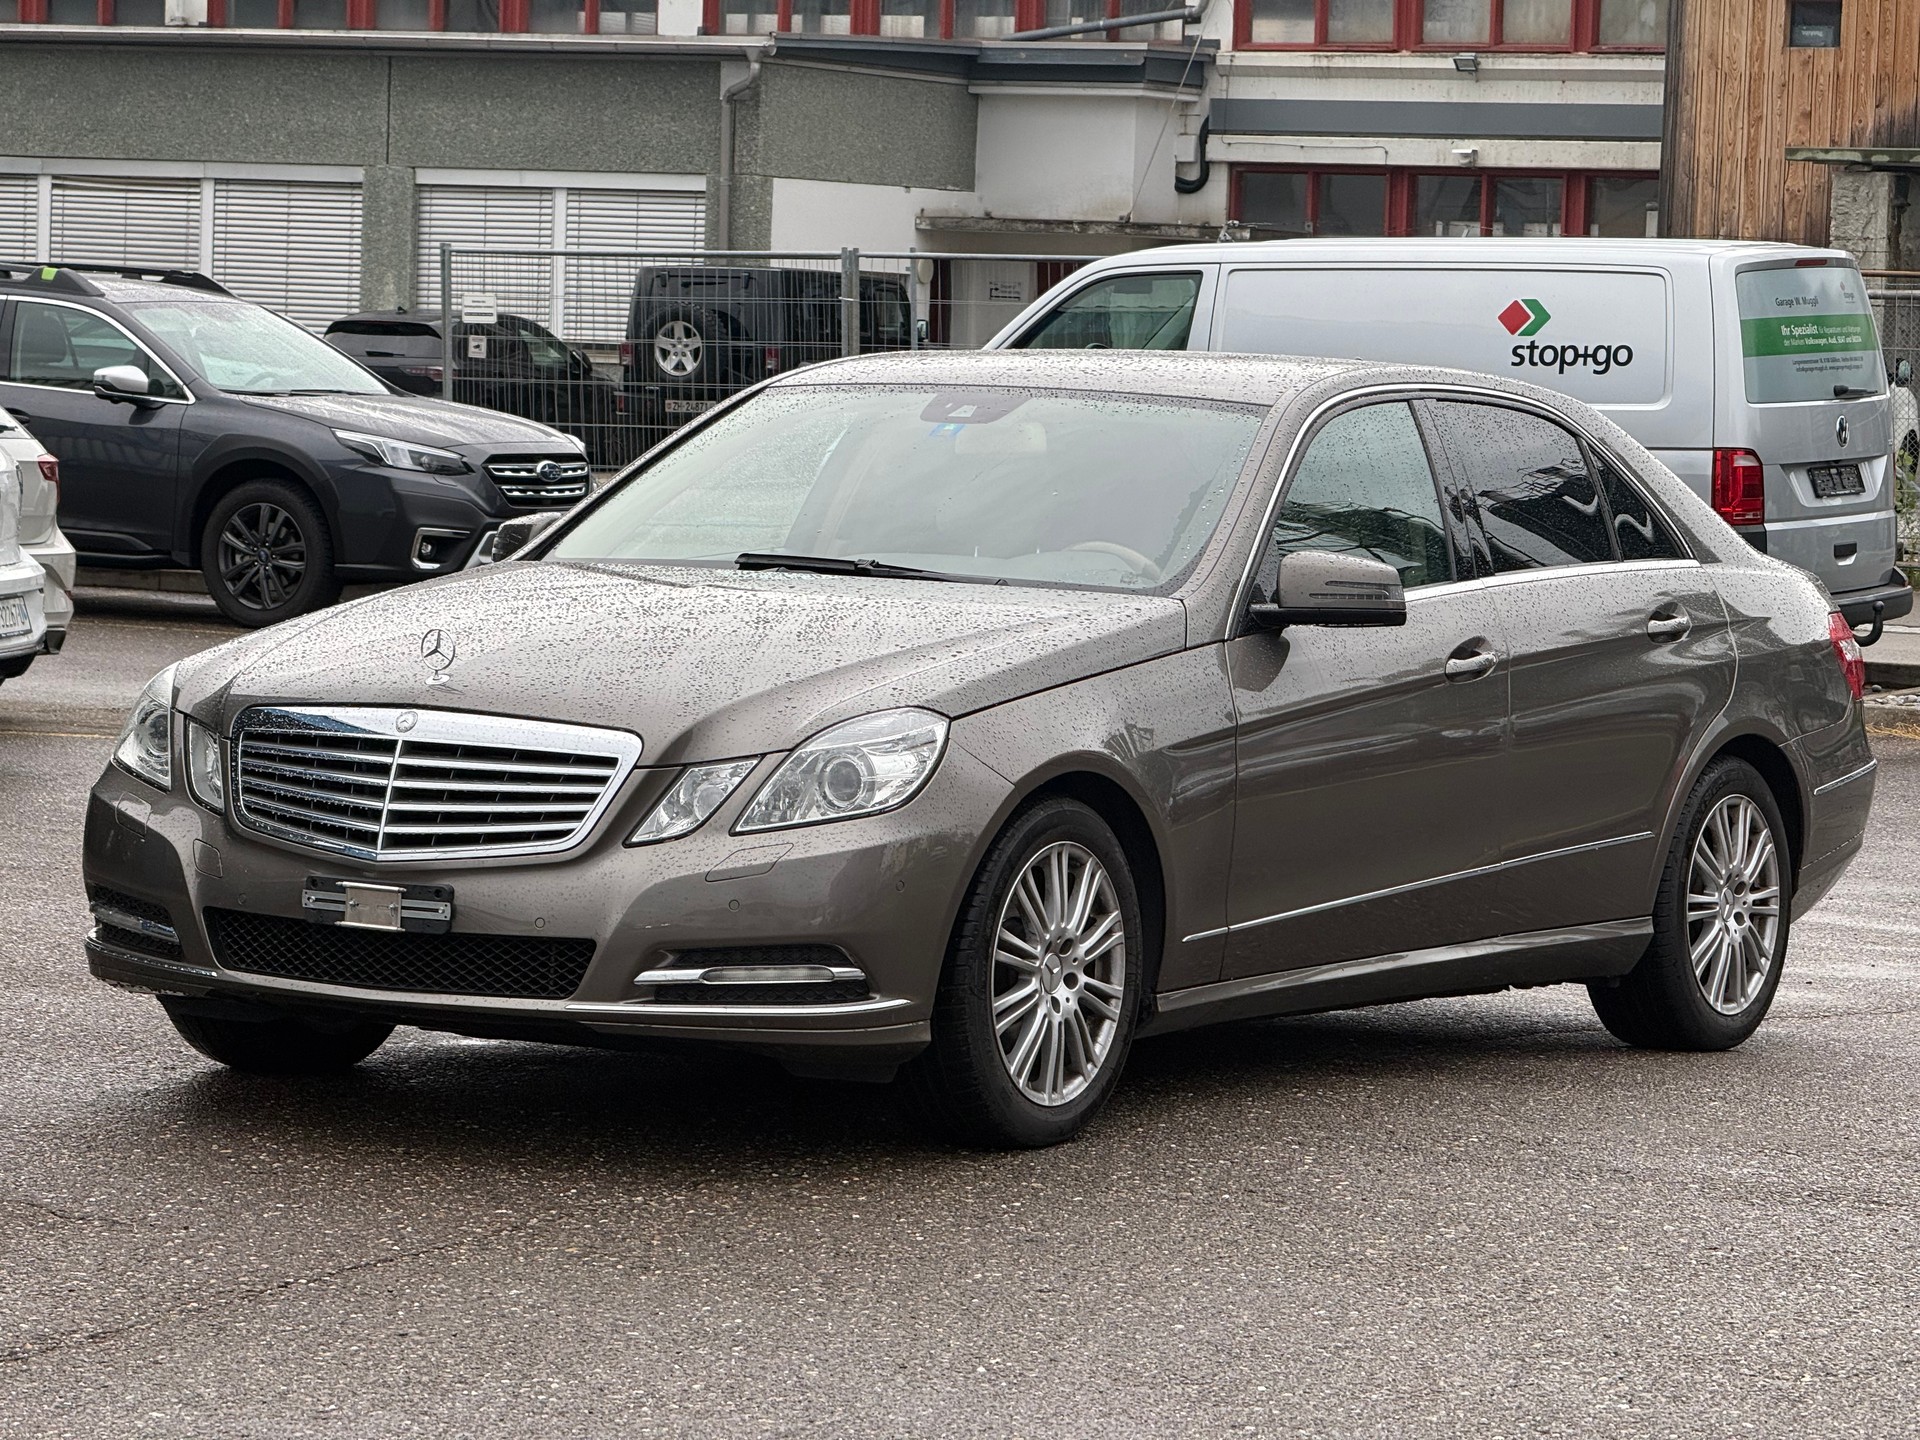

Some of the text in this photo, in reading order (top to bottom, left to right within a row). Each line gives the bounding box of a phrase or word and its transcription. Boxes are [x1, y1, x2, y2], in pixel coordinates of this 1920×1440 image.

[1775, 297, 1794, 308] Garage
[1802, 296, 1819, 307] Muggli
[1781, 325, 1790, 335] Ihr
[1791, 323, 1818, 337] Spezialist
[1511, 340, 1633, 375] stop+go
